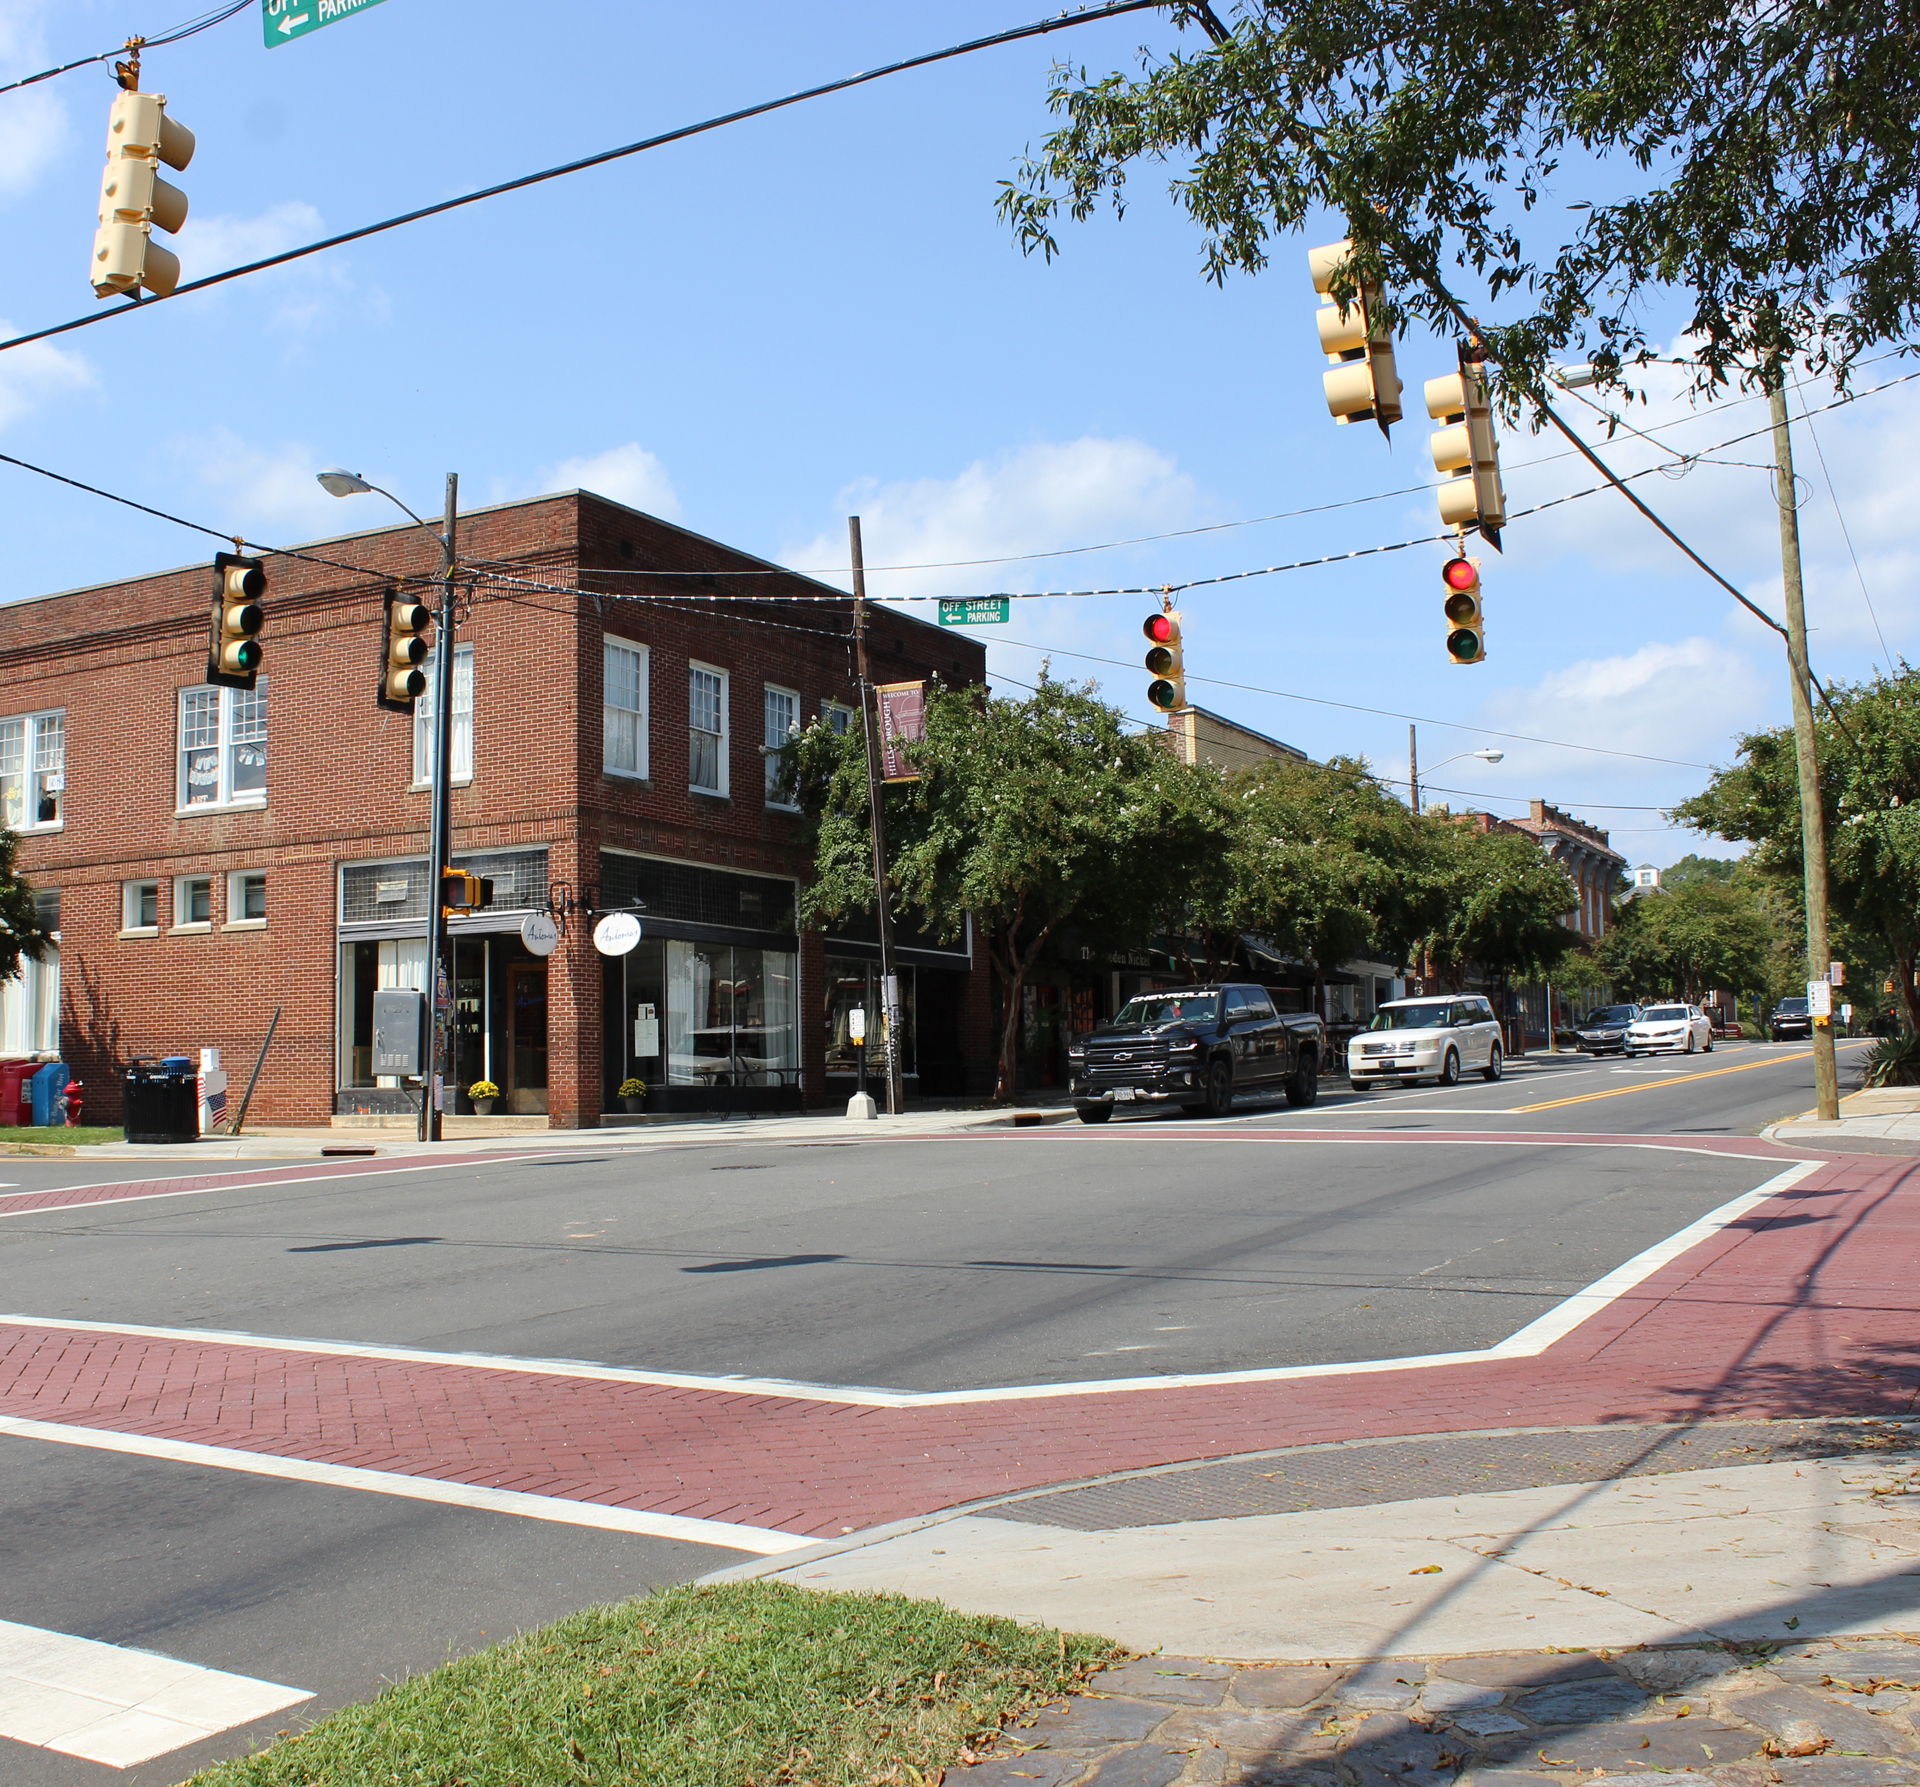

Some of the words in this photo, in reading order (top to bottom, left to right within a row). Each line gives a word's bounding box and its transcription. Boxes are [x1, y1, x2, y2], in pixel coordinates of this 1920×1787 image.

[268, 0, 297, 16] OF
[942, 602, 961, 612] OFF
[965, 600, 1002, 611] STREET
[967, 611, 1001, 623] PARKING
[882, 690, 909, 699] WELCOME
[882, 701, 897, 776] HILLSOROUGH
[1128, 952, 1150, 966] Nickel
[1129, 992, 1219, 1003] CHEVROLET
